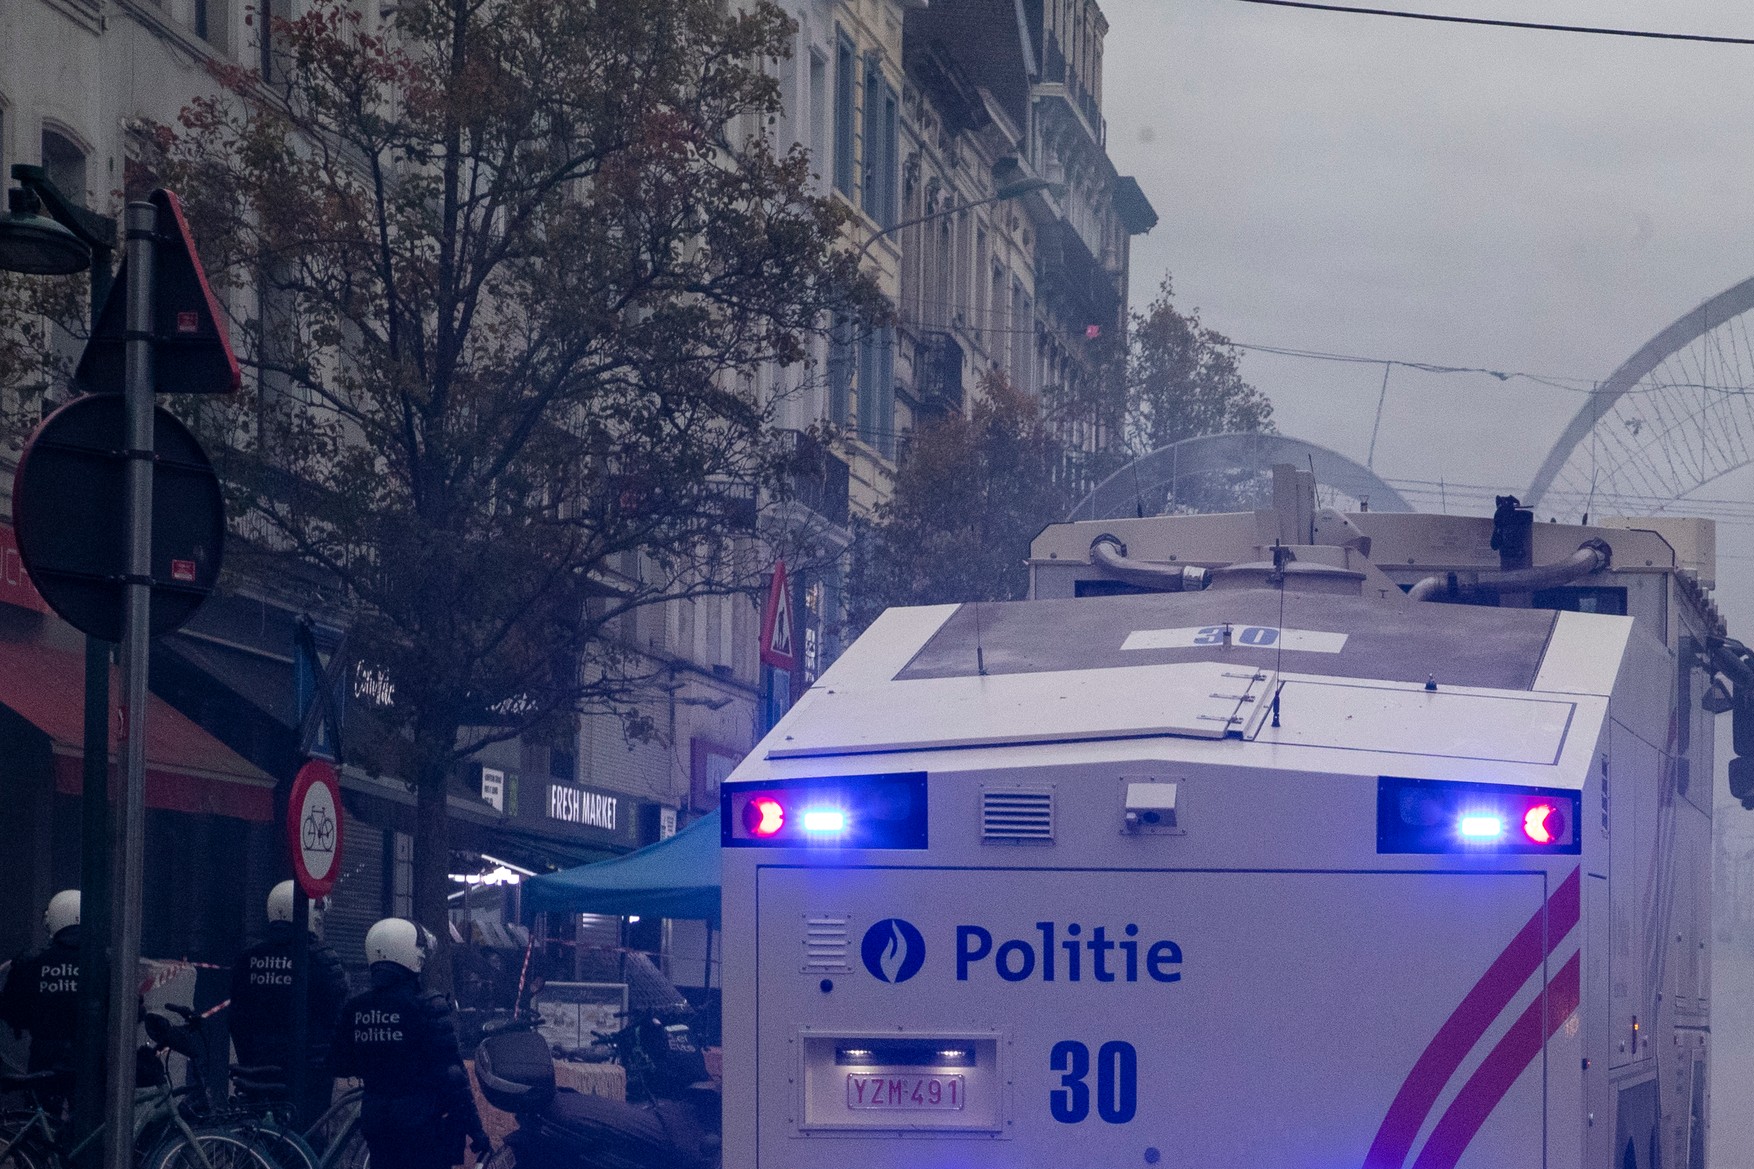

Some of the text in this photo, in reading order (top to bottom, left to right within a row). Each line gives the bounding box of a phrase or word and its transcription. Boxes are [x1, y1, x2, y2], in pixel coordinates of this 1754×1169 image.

[1194, 627, 1279, 646] 30
[551, 784, 580, 822] FRESH
[582, 791, 617, 830] MARKET
[957, 922, 1183, 983] Politie
[40, 963, 79, 978] Polic
[39, 980, 78, 993] Polit
[354, 1011, 400, 1025] Police
[354, 1027, 403, 1042] Politie
[854, 1078, 958, 1105] YZM-491
[1050, 1040, 1137, 1124] 30
